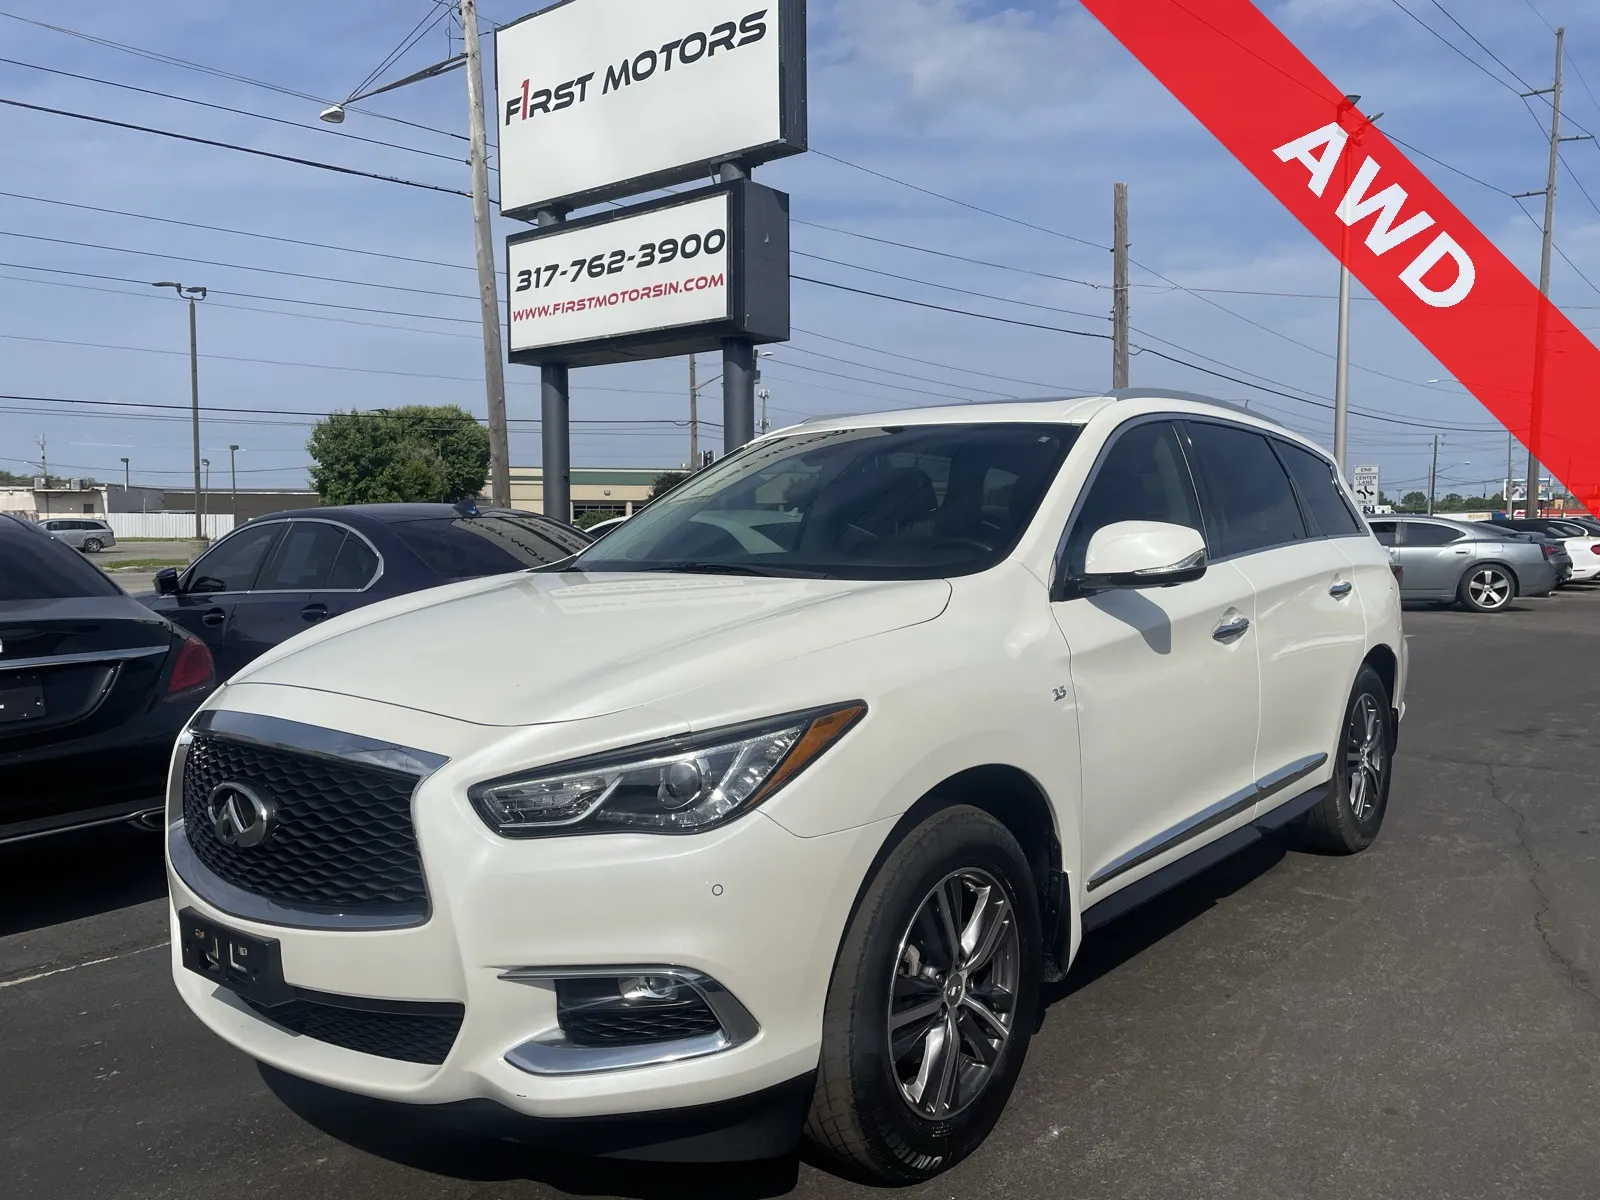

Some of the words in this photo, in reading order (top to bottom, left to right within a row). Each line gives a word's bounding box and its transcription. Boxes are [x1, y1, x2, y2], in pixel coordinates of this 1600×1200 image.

[602, 9, 768, 95] MOTORS
[515, 228, 726, 293] 317-762-3900
[512, 273, 724, 322] WWW.FIRSTMOTORSIN.COM
